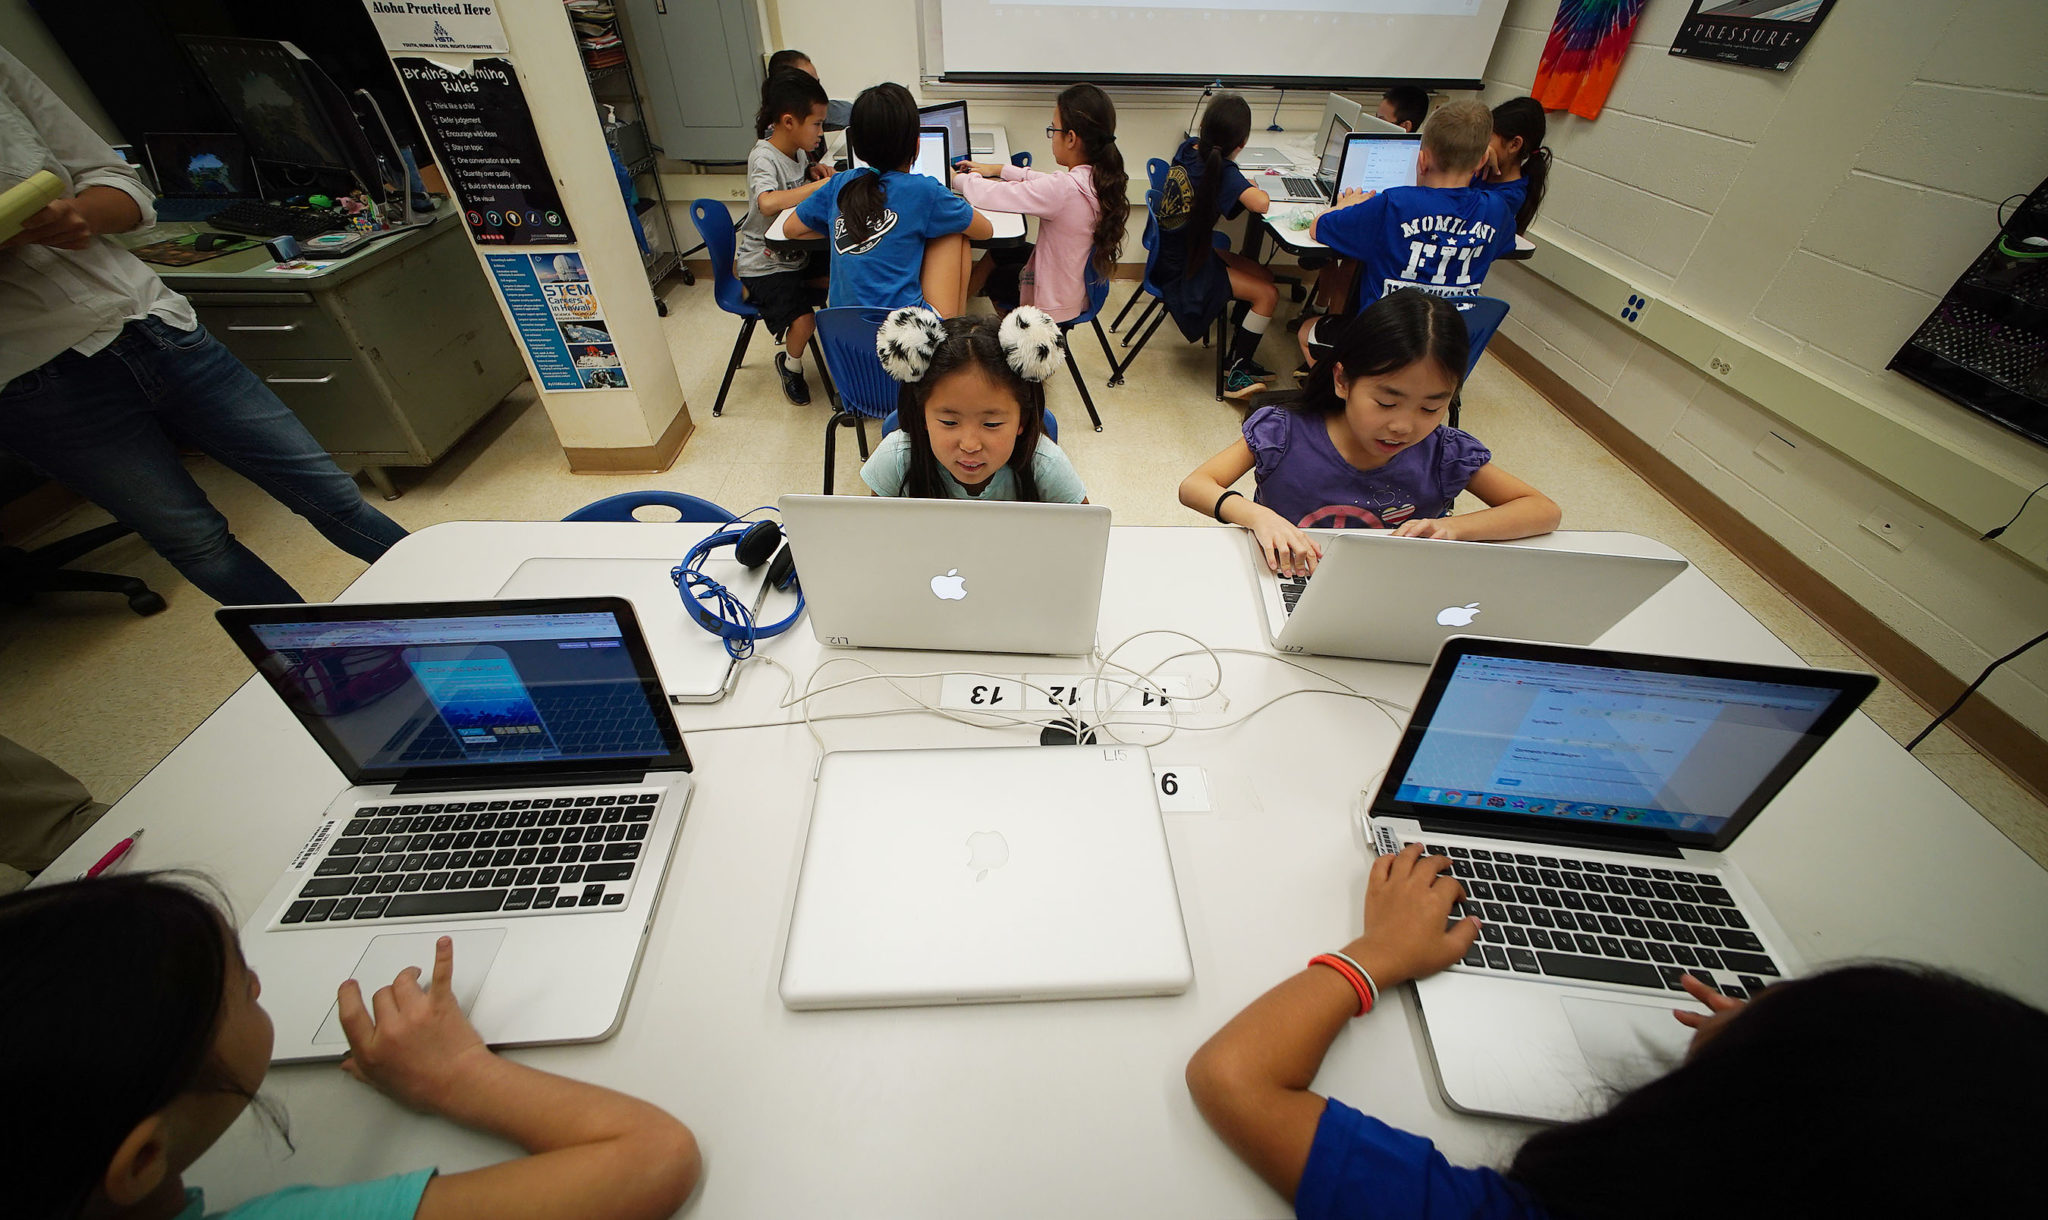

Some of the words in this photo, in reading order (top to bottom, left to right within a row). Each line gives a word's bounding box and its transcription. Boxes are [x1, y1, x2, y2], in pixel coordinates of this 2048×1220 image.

[374, 2, 404, 14] Aloha
[406, 2, 461, 14] Practiced
[463, 4, 491, 15] Here
[1694, 24, 1792, 47] PRESSURE
[441, 80, 479, 94] Rules
[1400, 214, 1496, 244] MOMILANI
[1400, 240, 1484, 285] FIT
[544, 284, 592, 296] STEM
[970, 686, 1004, 705] 13
[1049, 686, 1081, 706] 12
[1142, 688, 1171, 707] 11
[1104, 749, 1128, 761] L15
